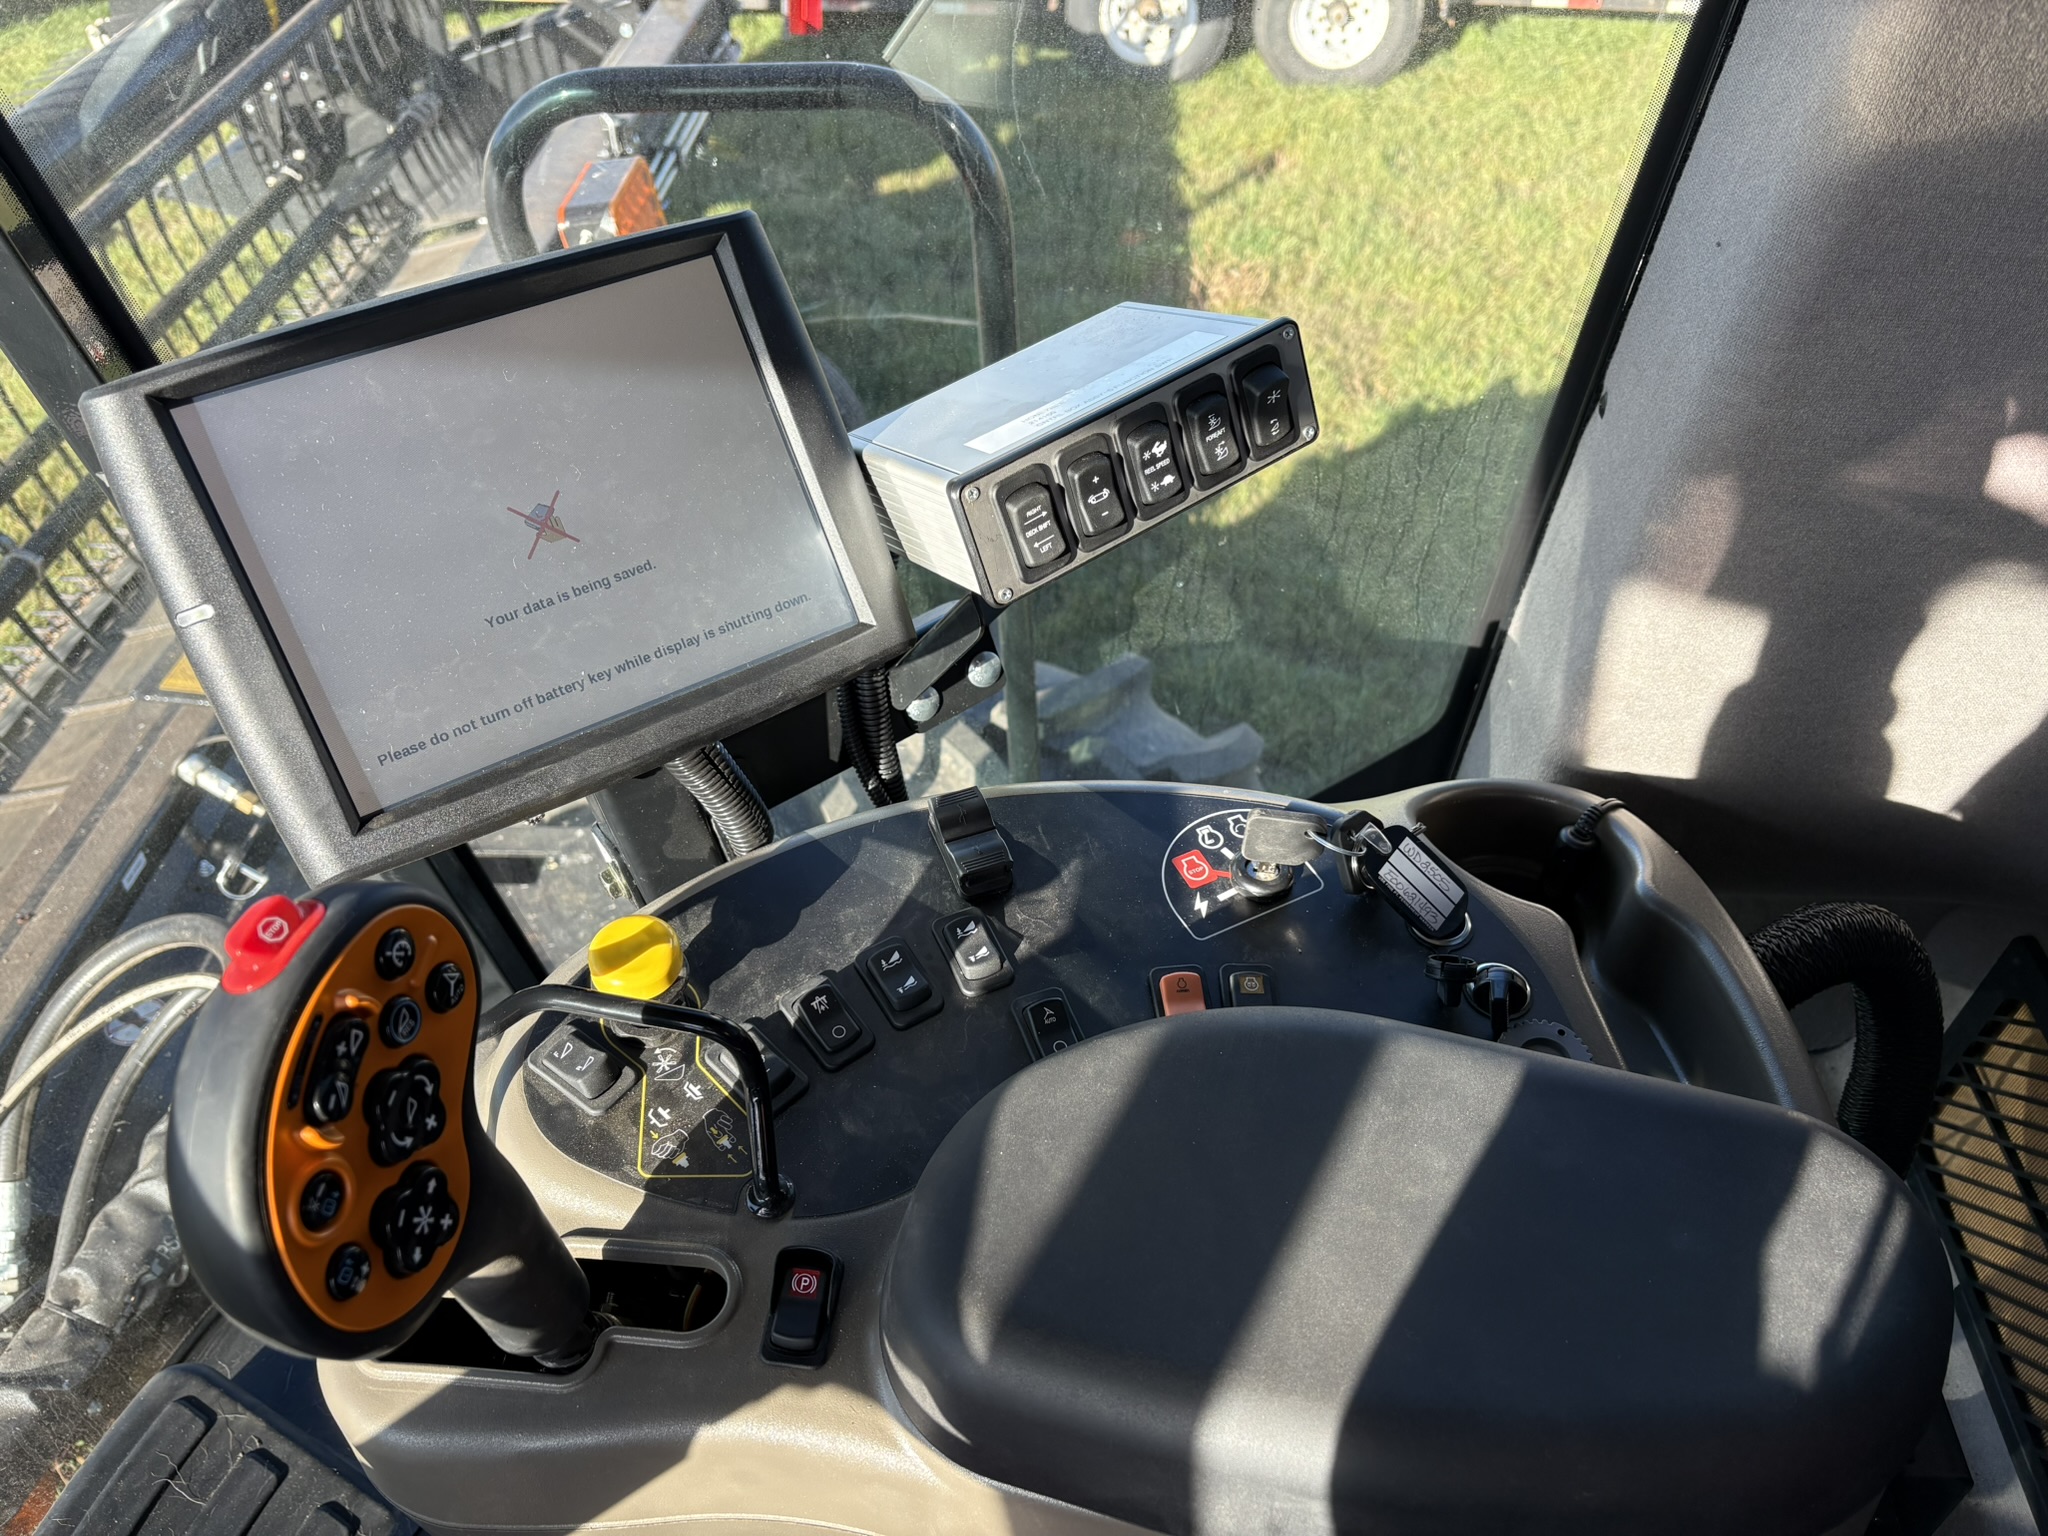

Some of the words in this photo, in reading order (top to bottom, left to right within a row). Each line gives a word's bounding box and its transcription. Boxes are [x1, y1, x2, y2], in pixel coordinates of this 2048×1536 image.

[1144, 465, 1156, 476] REEL
[1155, 457, 1171, 470] SPEED
[1026, 504, 1042, 518] RIGHT
[1025, 526, 1039, 539] DECK
[1038, 519, 1051, 532] SHIFT
[1040, 541, 1052, 554] LEFT
[484, 608, 520, 628] Your
[522, 597, 555, 616] data
[556, 591, 570, 603] is
[571, 576, 612, 598] being
[613, 559, 657, 583] saved.
[377, 740, 427, 767] Please
[429, 729, 449, 746] do
[452, 719, 478, 738] not
[480, 706, 511, 726] turn
[513, 697, 534, 714] off
[535, 677, 585, 705] battery
[587, 668, 612, 685] key
[614, 652, 651, 674] while
[653, 633, 701, 660] display
[703, 628, 716, 640] is
[718, 606, 773, 635] shutting
[774, 591, 812, 614] down.
[1188, 866, 1204, 875] STOP
[1384, 869, 1439, 925] E00621493
[1398, 895, 1420, 917] PERMANENT
[265, 919, 282, 938] STOP
[1044, 1016, 1057, 1025] AUTO
[800, 1277, 810, 1290] P
